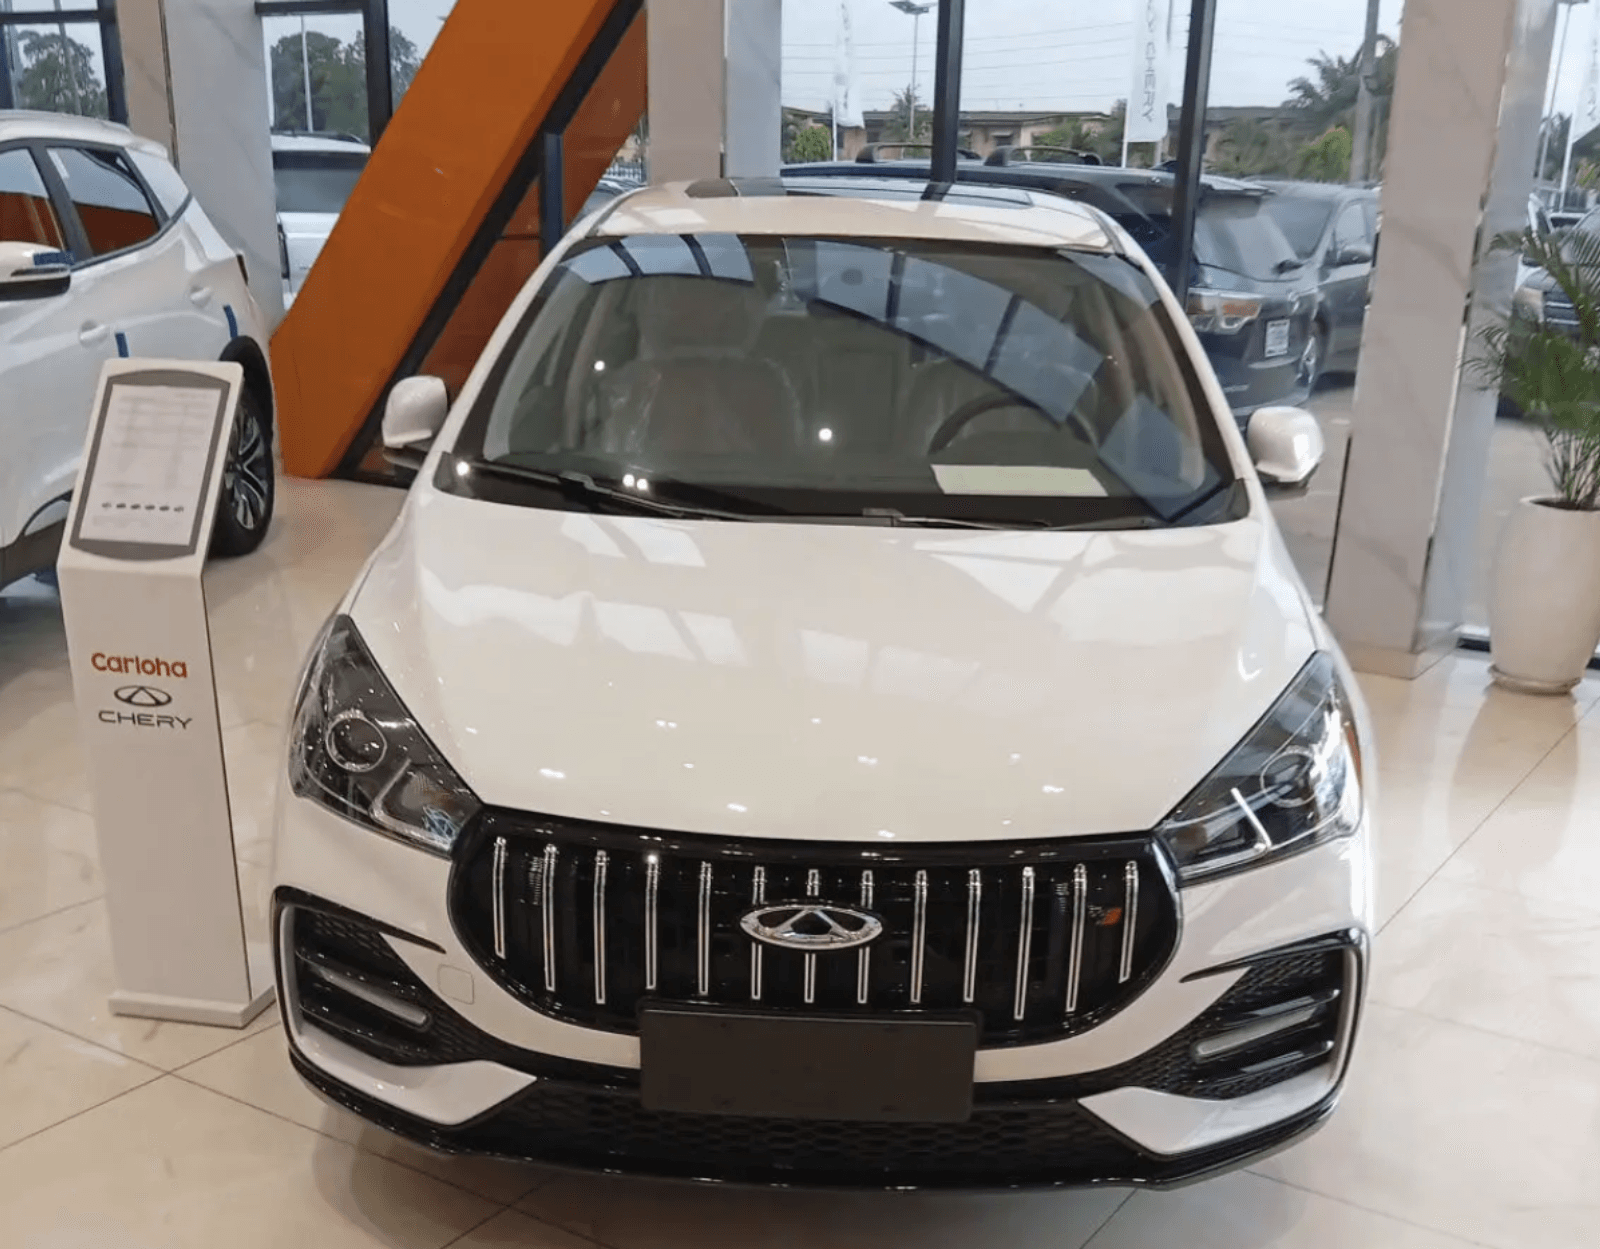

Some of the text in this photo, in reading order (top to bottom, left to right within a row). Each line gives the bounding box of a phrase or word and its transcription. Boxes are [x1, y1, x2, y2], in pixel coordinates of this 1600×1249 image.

[1142, 41, 1156, 122] CHERY
[91, 652, 187, 678] Carloha
[98, 710, 193, 730] CHERY
